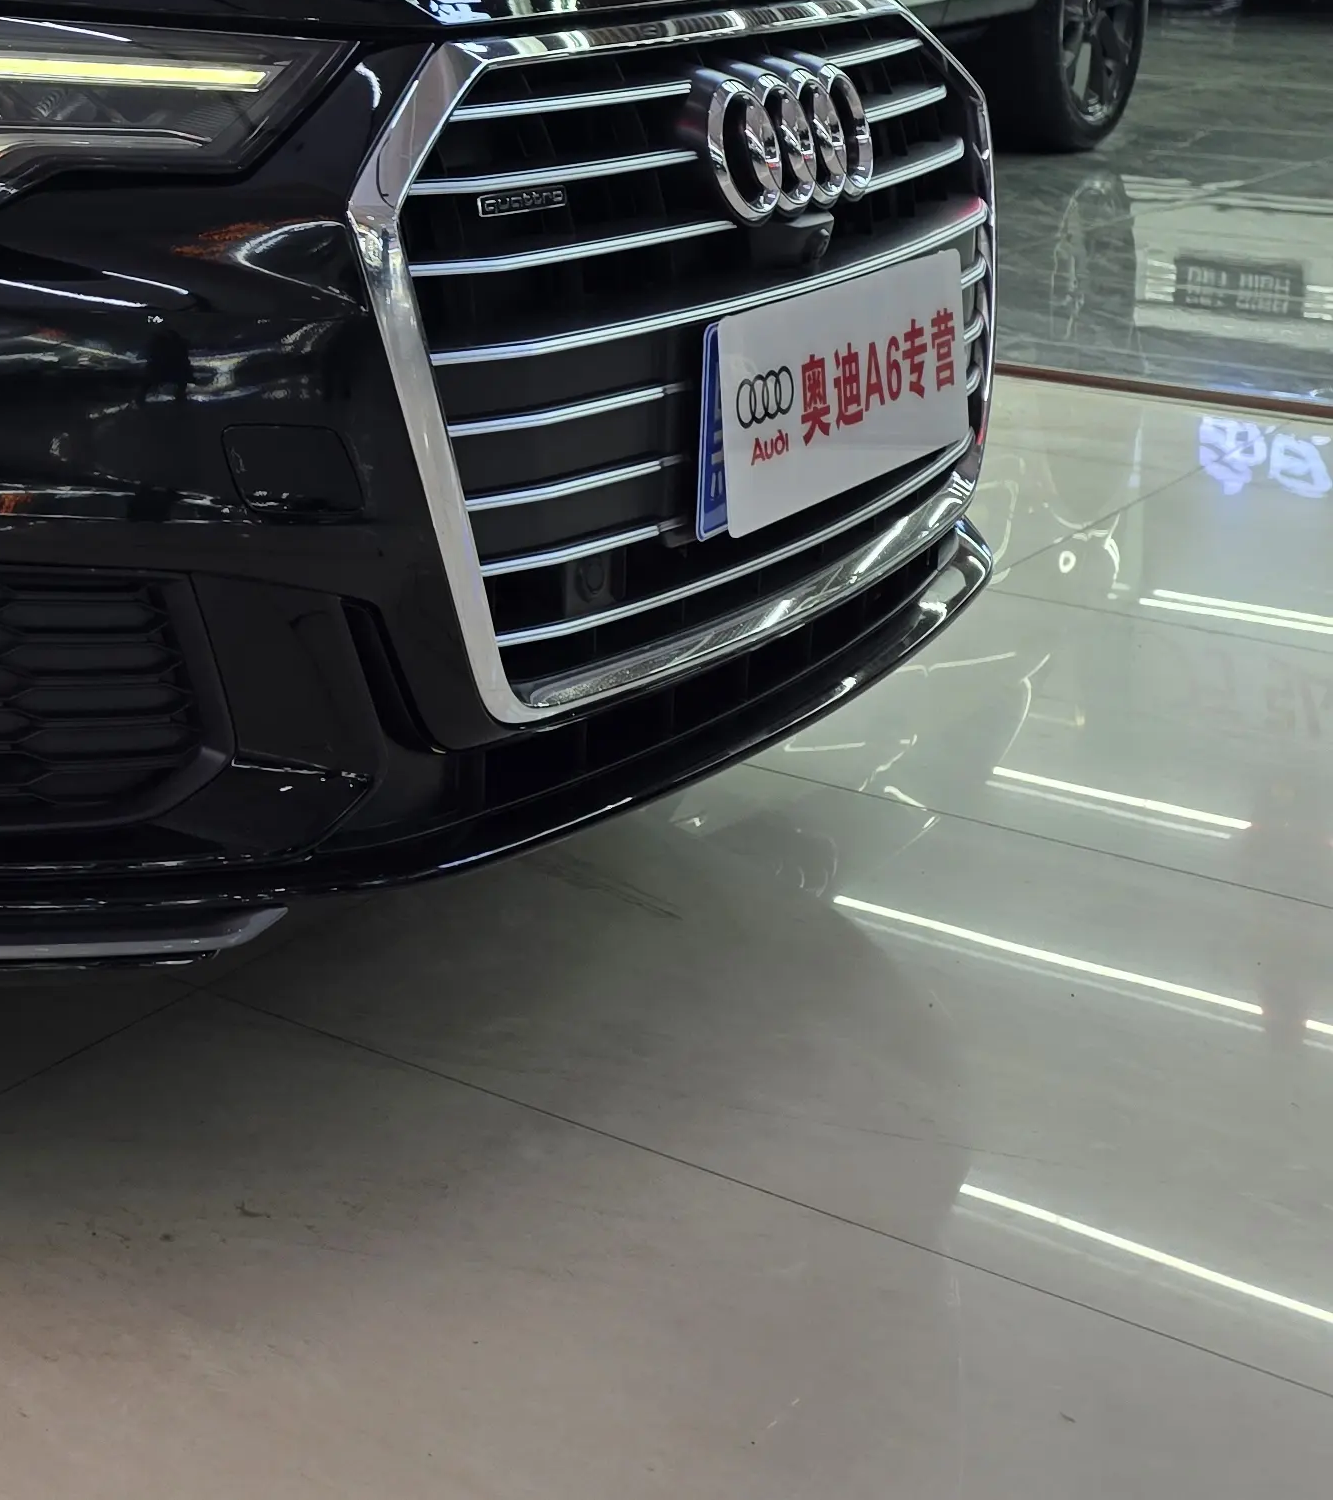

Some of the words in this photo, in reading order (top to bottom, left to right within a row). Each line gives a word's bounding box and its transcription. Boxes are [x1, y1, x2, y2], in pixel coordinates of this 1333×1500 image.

[484, 190, 564, 214] quattro
[800, 307, 956, 445] 奥迪A6专营
[750, 428, 790, 466] Audi
